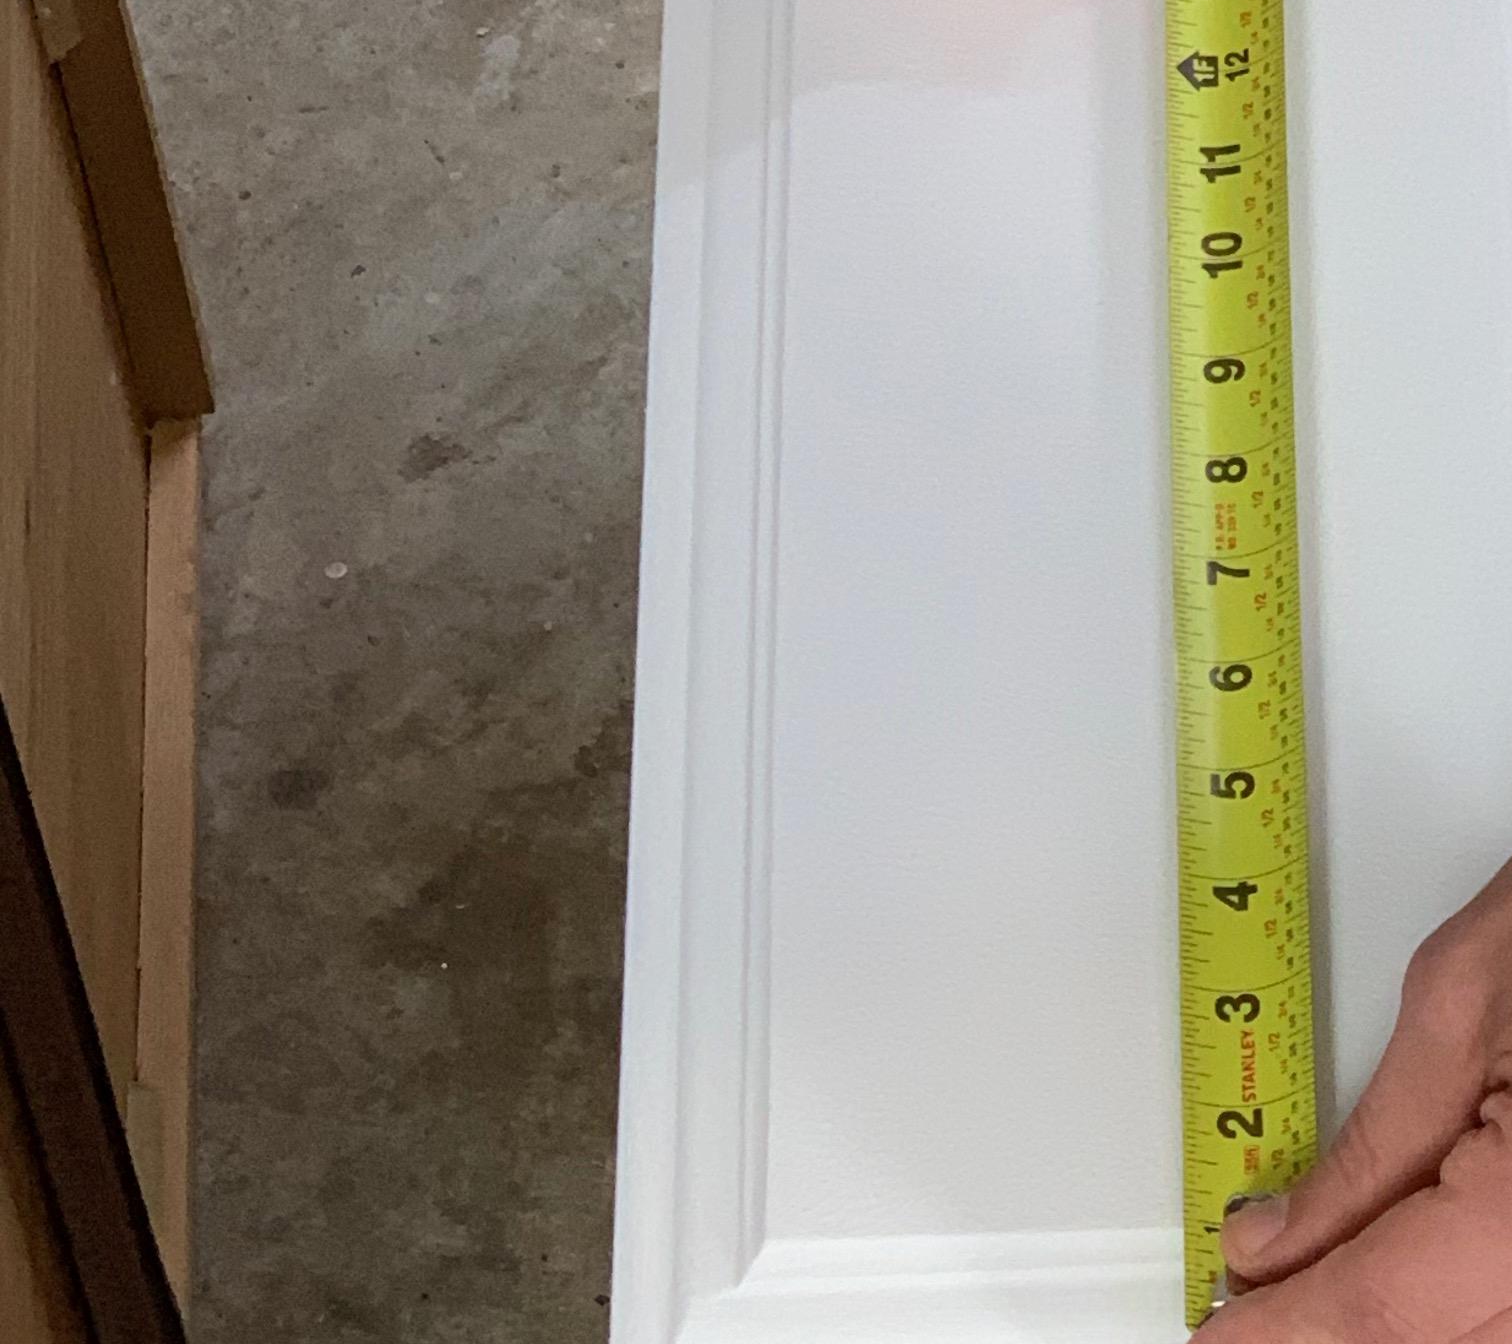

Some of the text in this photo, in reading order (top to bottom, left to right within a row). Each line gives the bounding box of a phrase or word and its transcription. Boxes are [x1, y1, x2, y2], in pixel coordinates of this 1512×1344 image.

[1224, 48, 1250, 82] 12
[1198, 143, 1241, 184] 11
[1200, 231, 1243, 279] 10
[1203, 358, 1245, 384] 9
[1204, 455, 1248, 484] 8
[1206, 561, 1250, 586] 7
[1208, 663, 1253, 692] 6
[1210, 771, 1255, 800] 5
[1212, 881, 1258, 912] 4
[1215, 993, 1260, 1023] 3
[1241, 1030, 1256, 1102] STANLEY
[1216, 1108, 1264, 1139] 2
